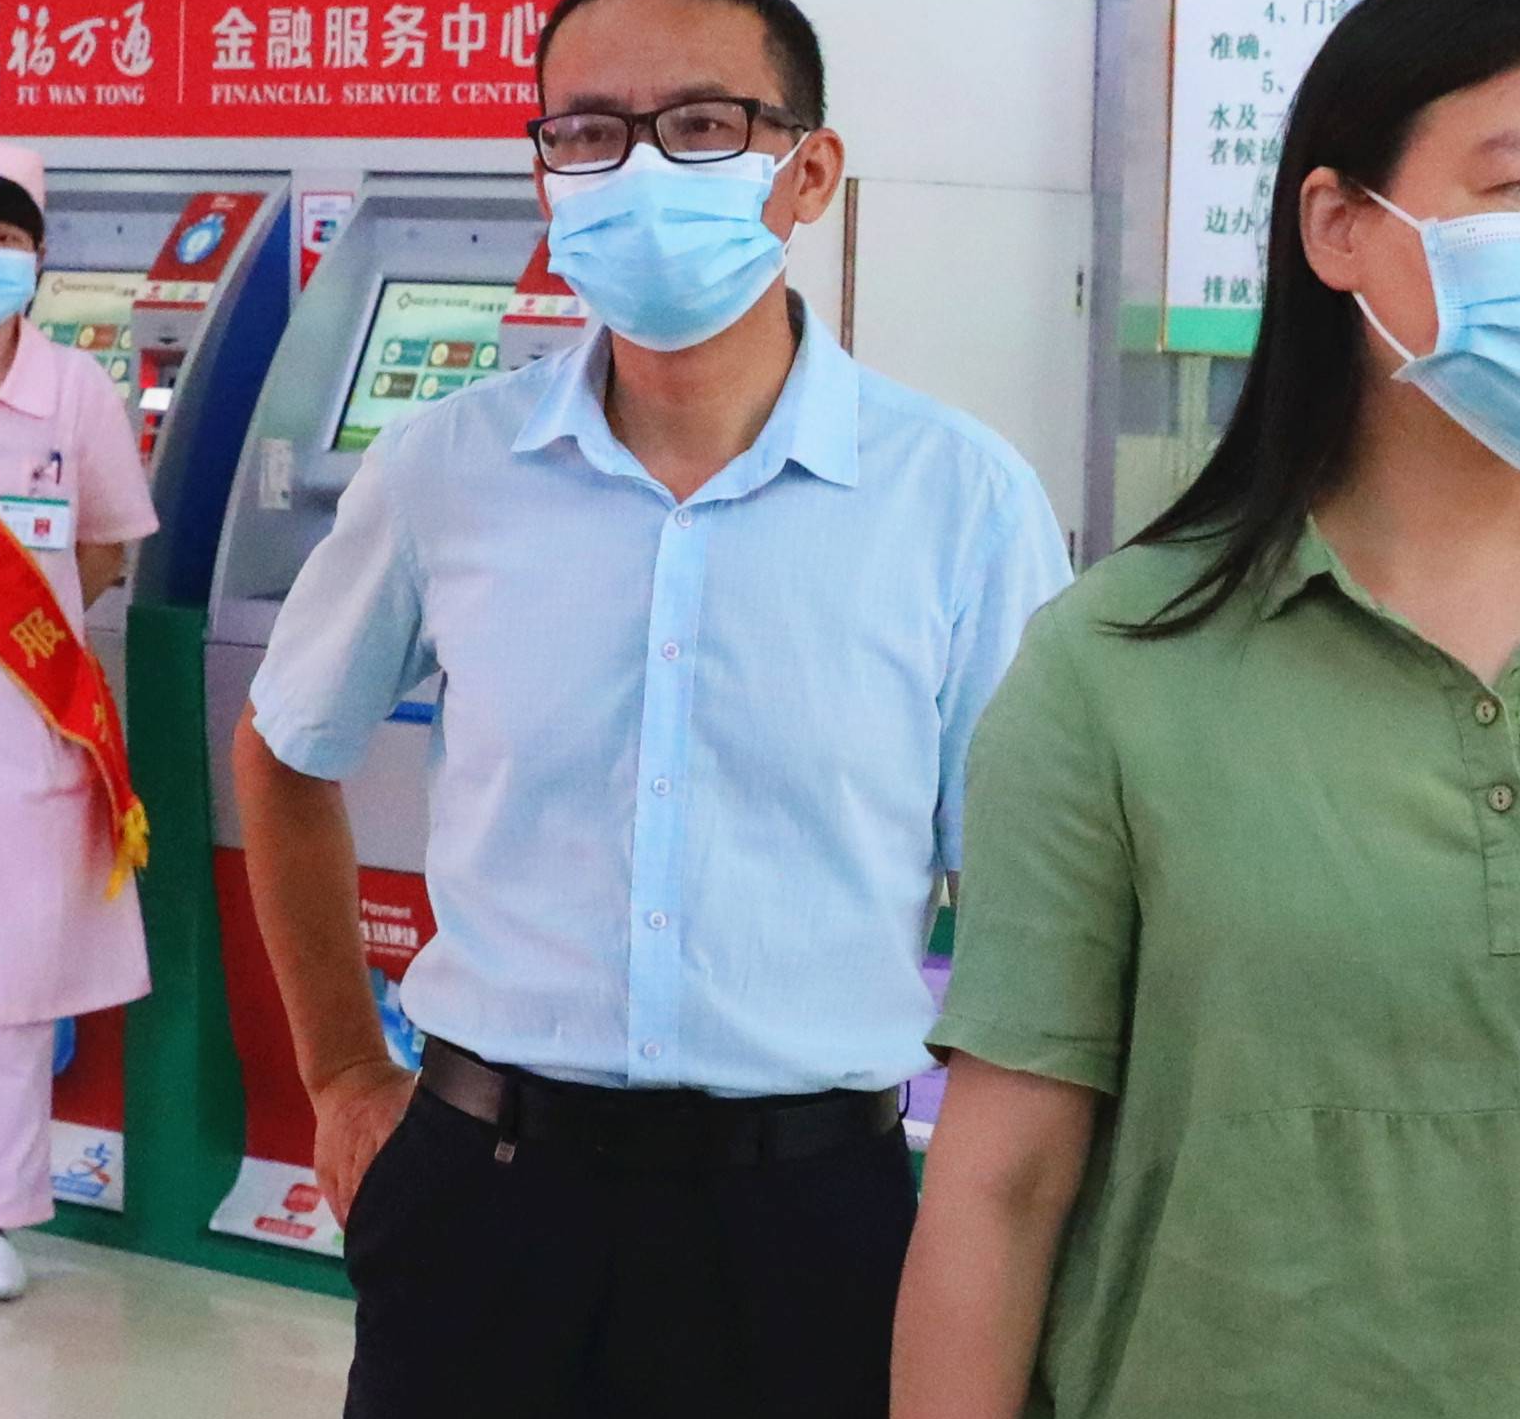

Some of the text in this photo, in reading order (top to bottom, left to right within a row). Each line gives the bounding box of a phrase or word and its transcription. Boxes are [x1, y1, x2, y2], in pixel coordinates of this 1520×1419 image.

[211, 1, 546, 72] 金融服务中心
[16, 83, 146, 106] FU WAN TONG
[210, 82, 331, 106] FINANCIAL
[341, 82, 441, 106] SERVICE
